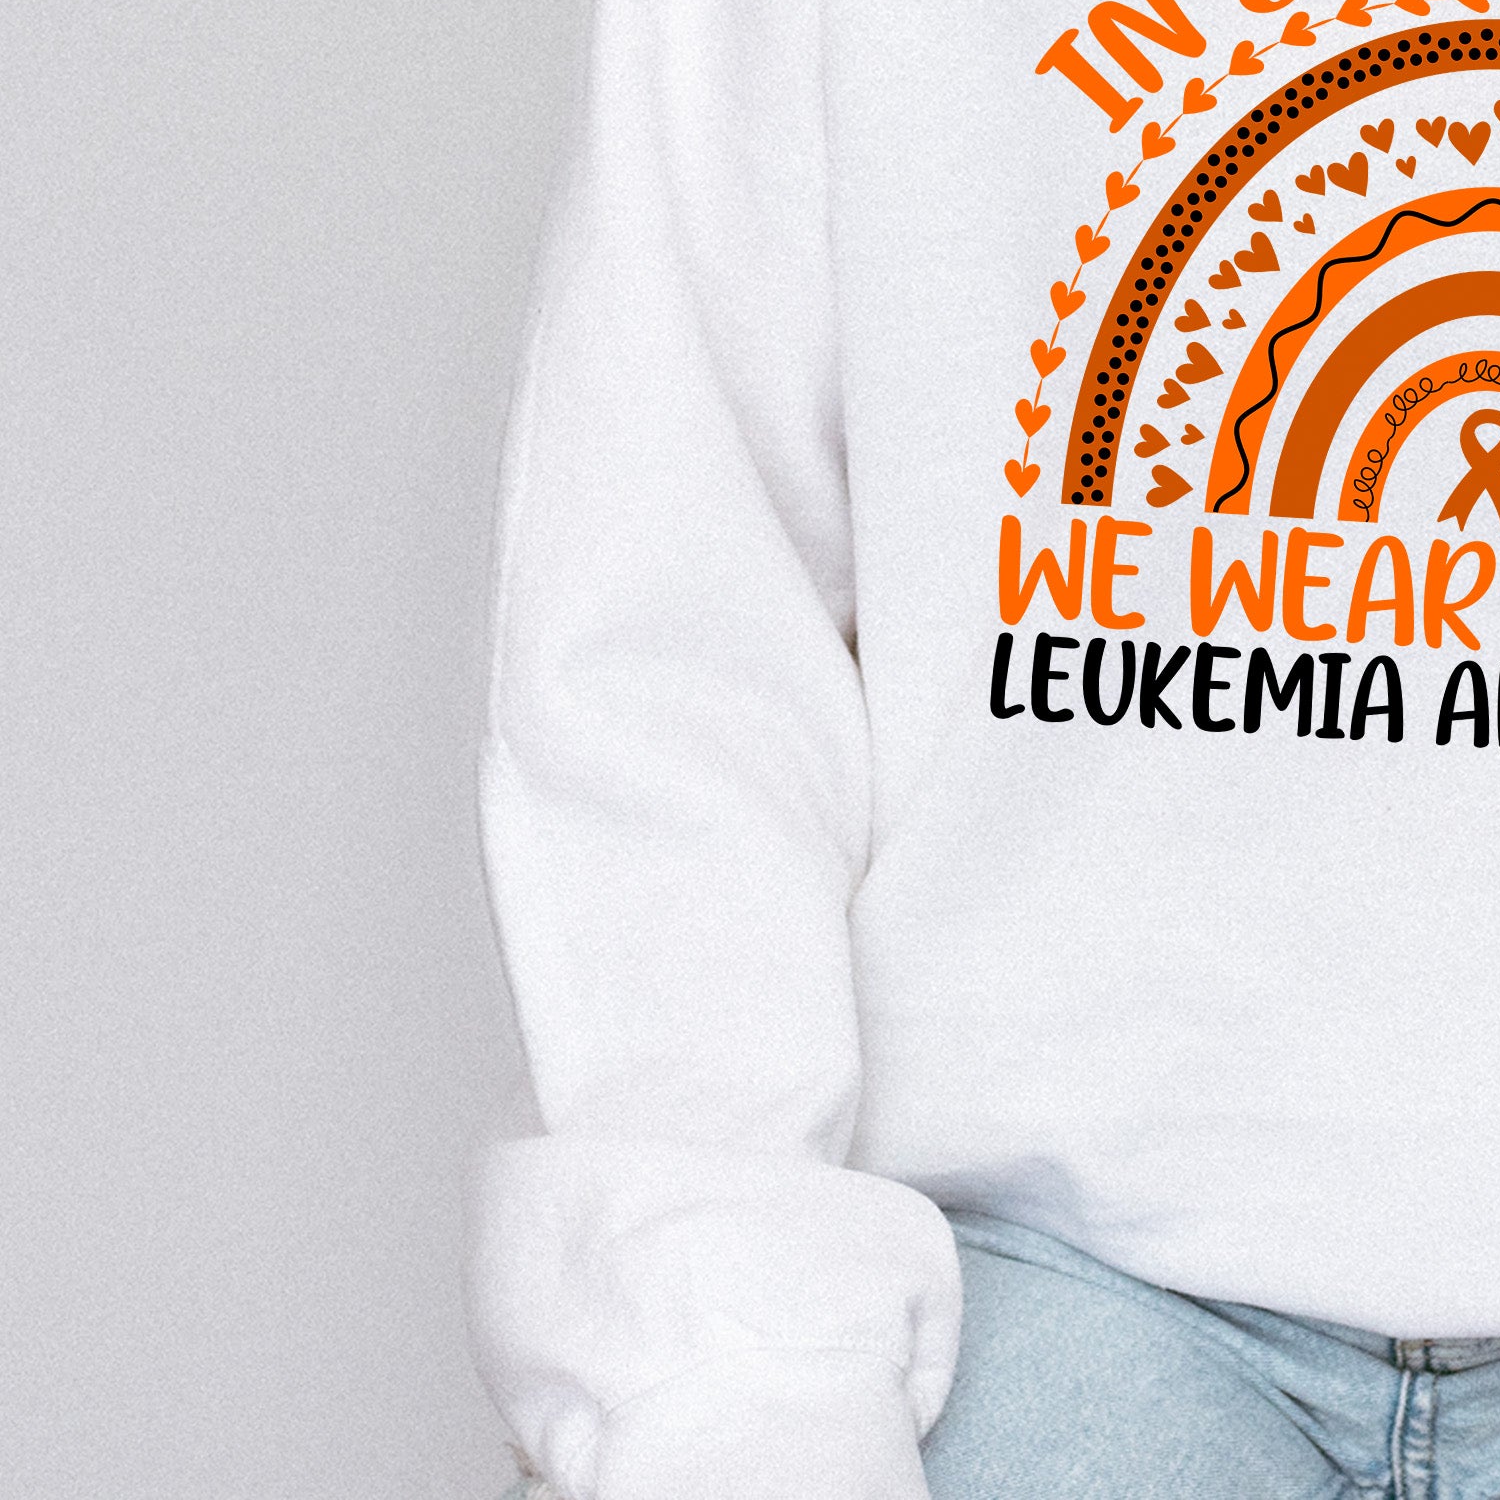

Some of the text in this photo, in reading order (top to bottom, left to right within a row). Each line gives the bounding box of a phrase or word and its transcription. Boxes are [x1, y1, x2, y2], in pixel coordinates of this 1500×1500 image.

[999, 515, 1152, 630] WE
[1190, 526, 1496, 650] WEAR
[989, 630, 1403, 742] LEUKEMIA
